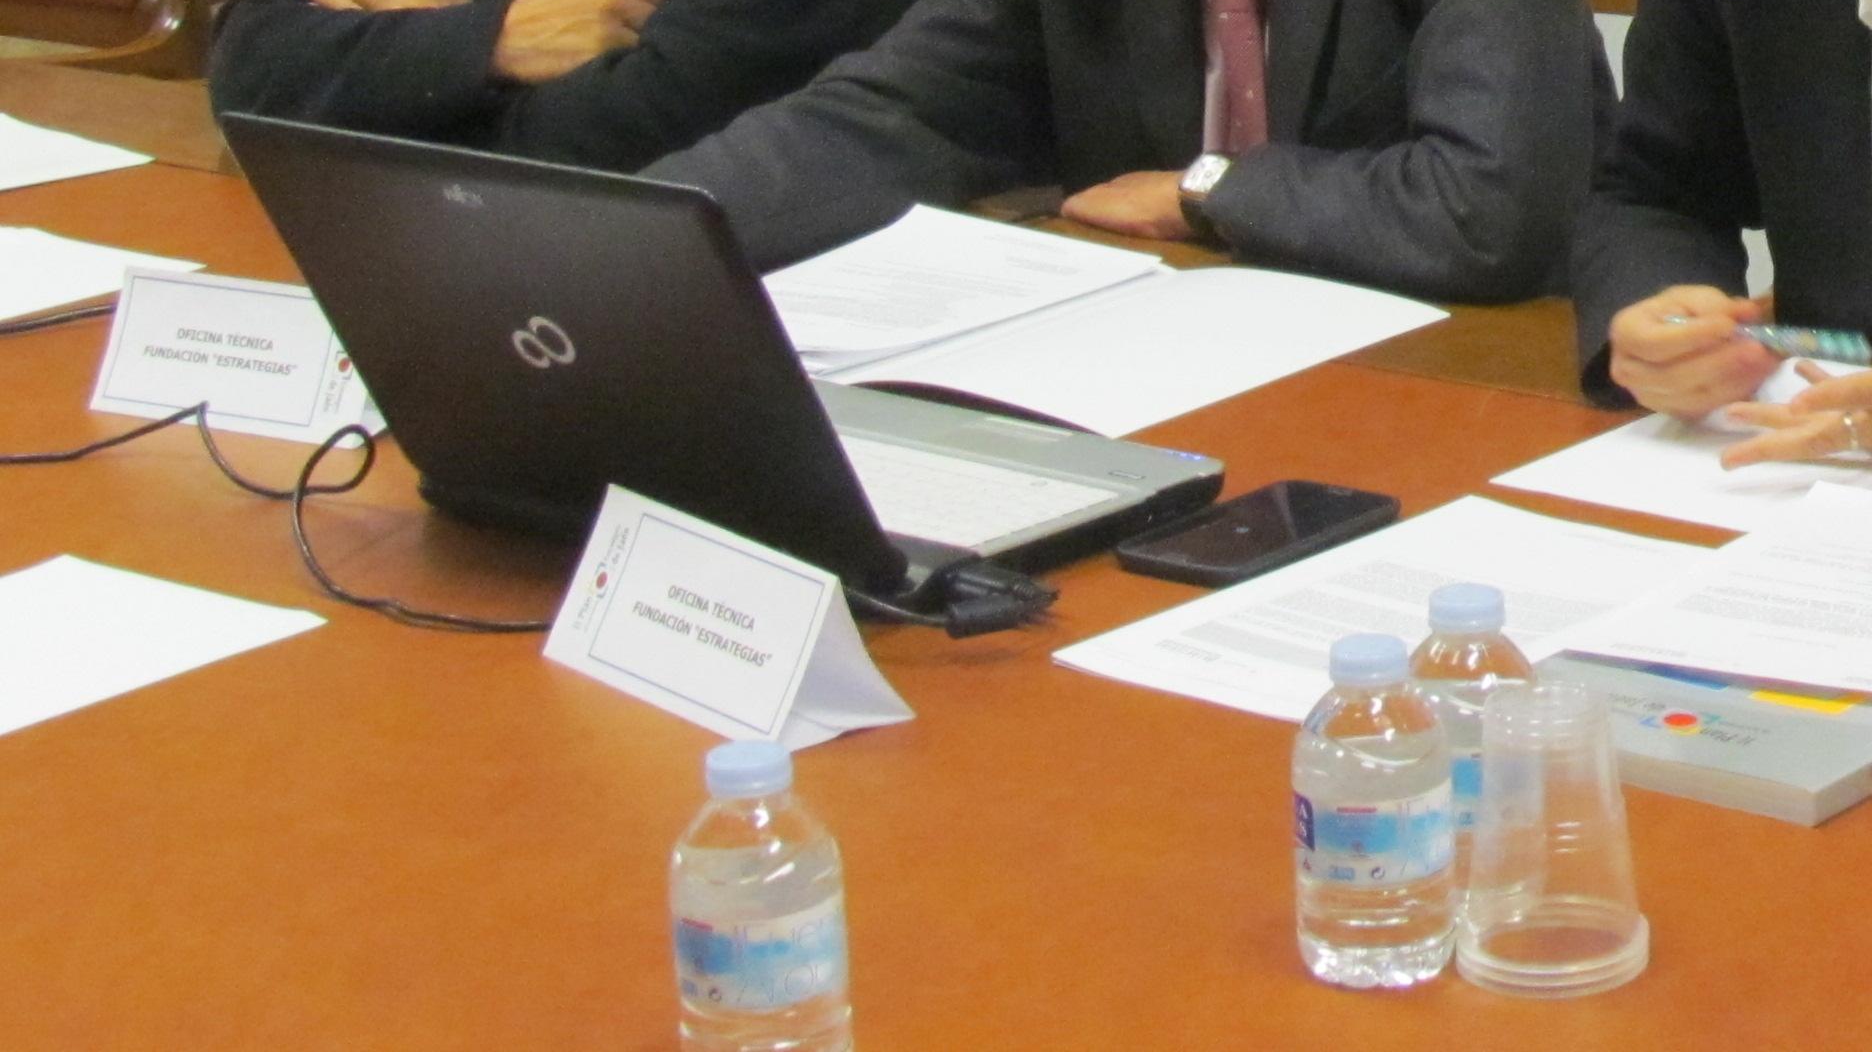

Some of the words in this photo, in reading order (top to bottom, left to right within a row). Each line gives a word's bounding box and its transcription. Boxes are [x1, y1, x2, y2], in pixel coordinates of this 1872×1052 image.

[176, 328, 224, 345] OFICINA
[632, 601, 693, 636] FUNDACIÓN
[667, 585, 710, 613] OFICINA
[711, 601, 755, 631] TÉCNICA
